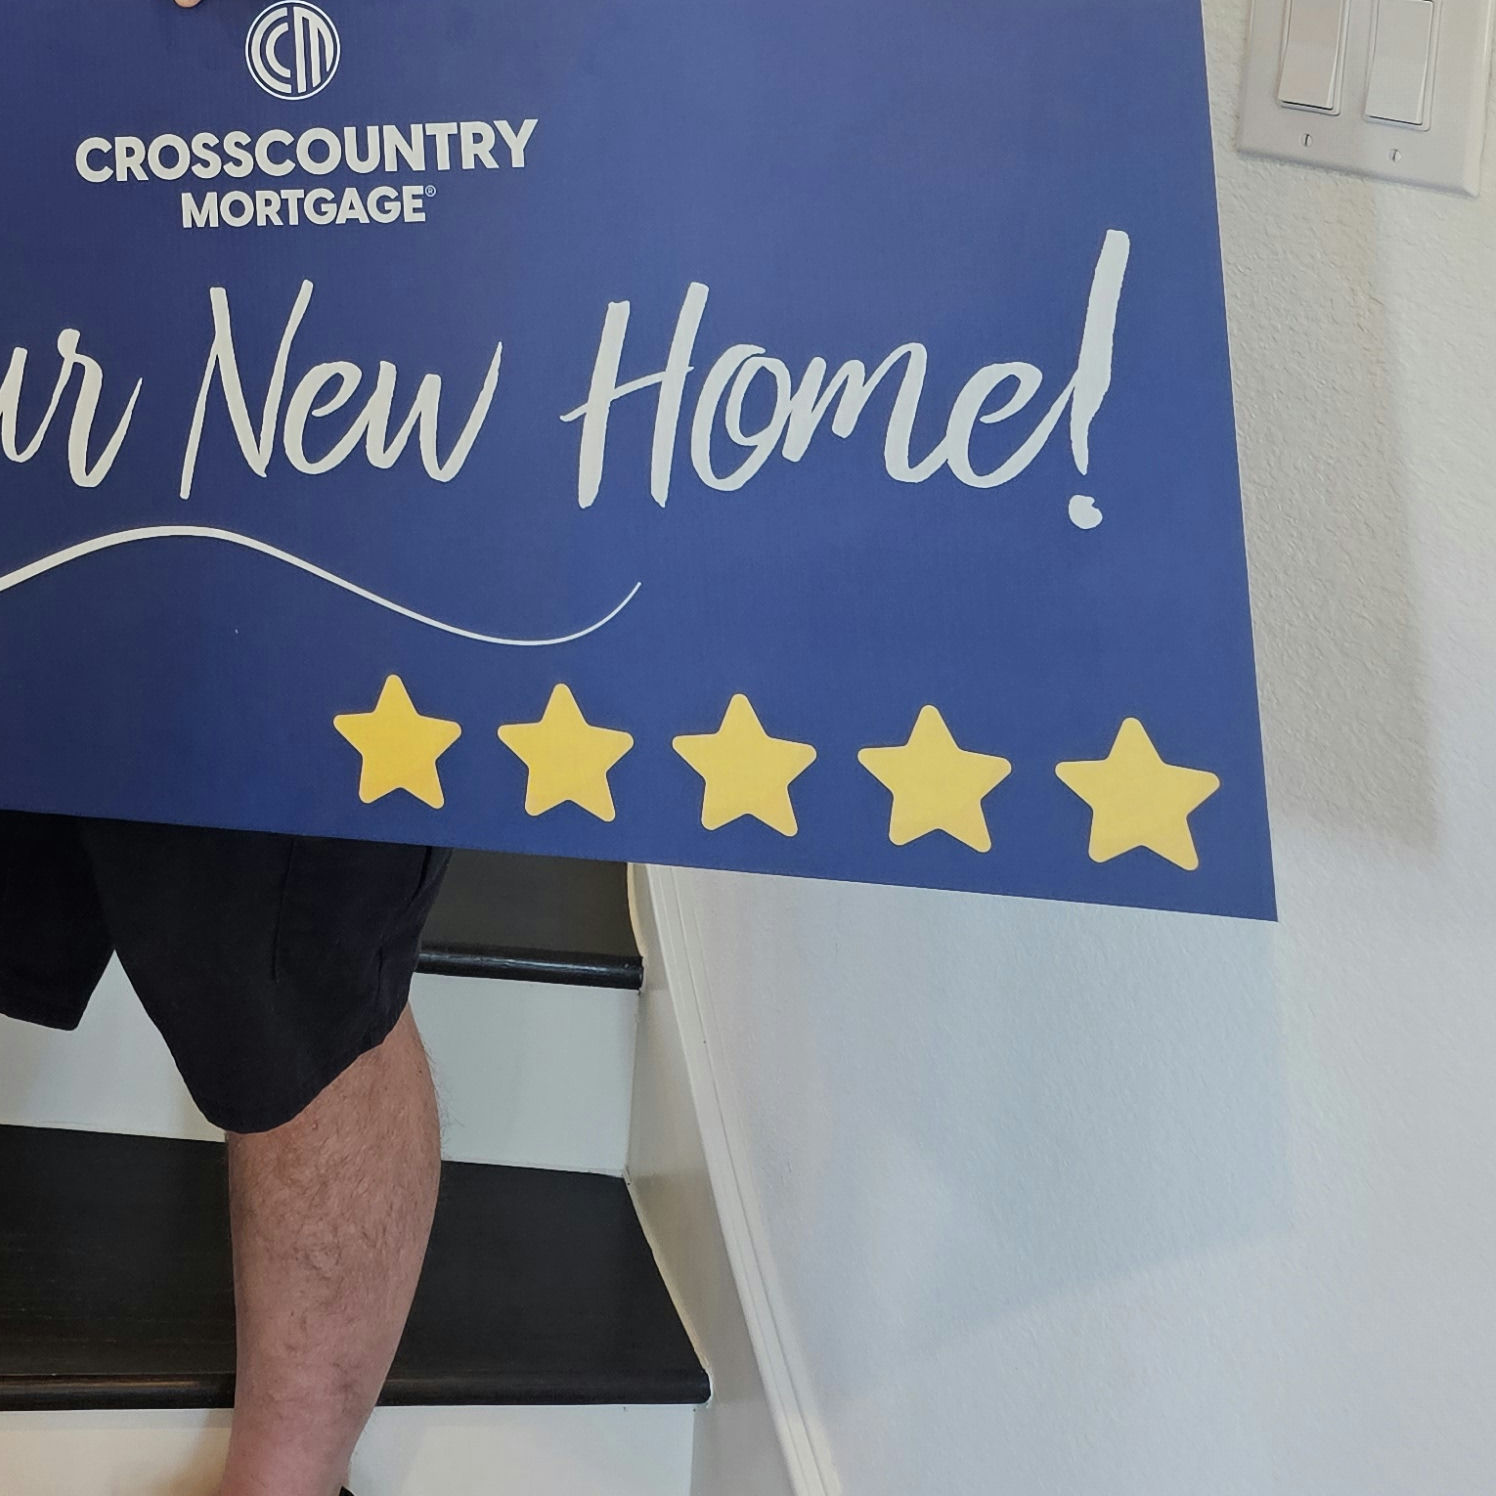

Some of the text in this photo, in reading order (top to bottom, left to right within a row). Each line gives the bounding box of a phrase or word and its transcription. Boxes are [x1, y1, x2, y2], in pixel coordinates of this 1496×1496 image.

[75, 118, 538, 183] CROSSCOUNTRY
[180, 280, 503, 499] New
[559, 229, 1131, 529] Home!
